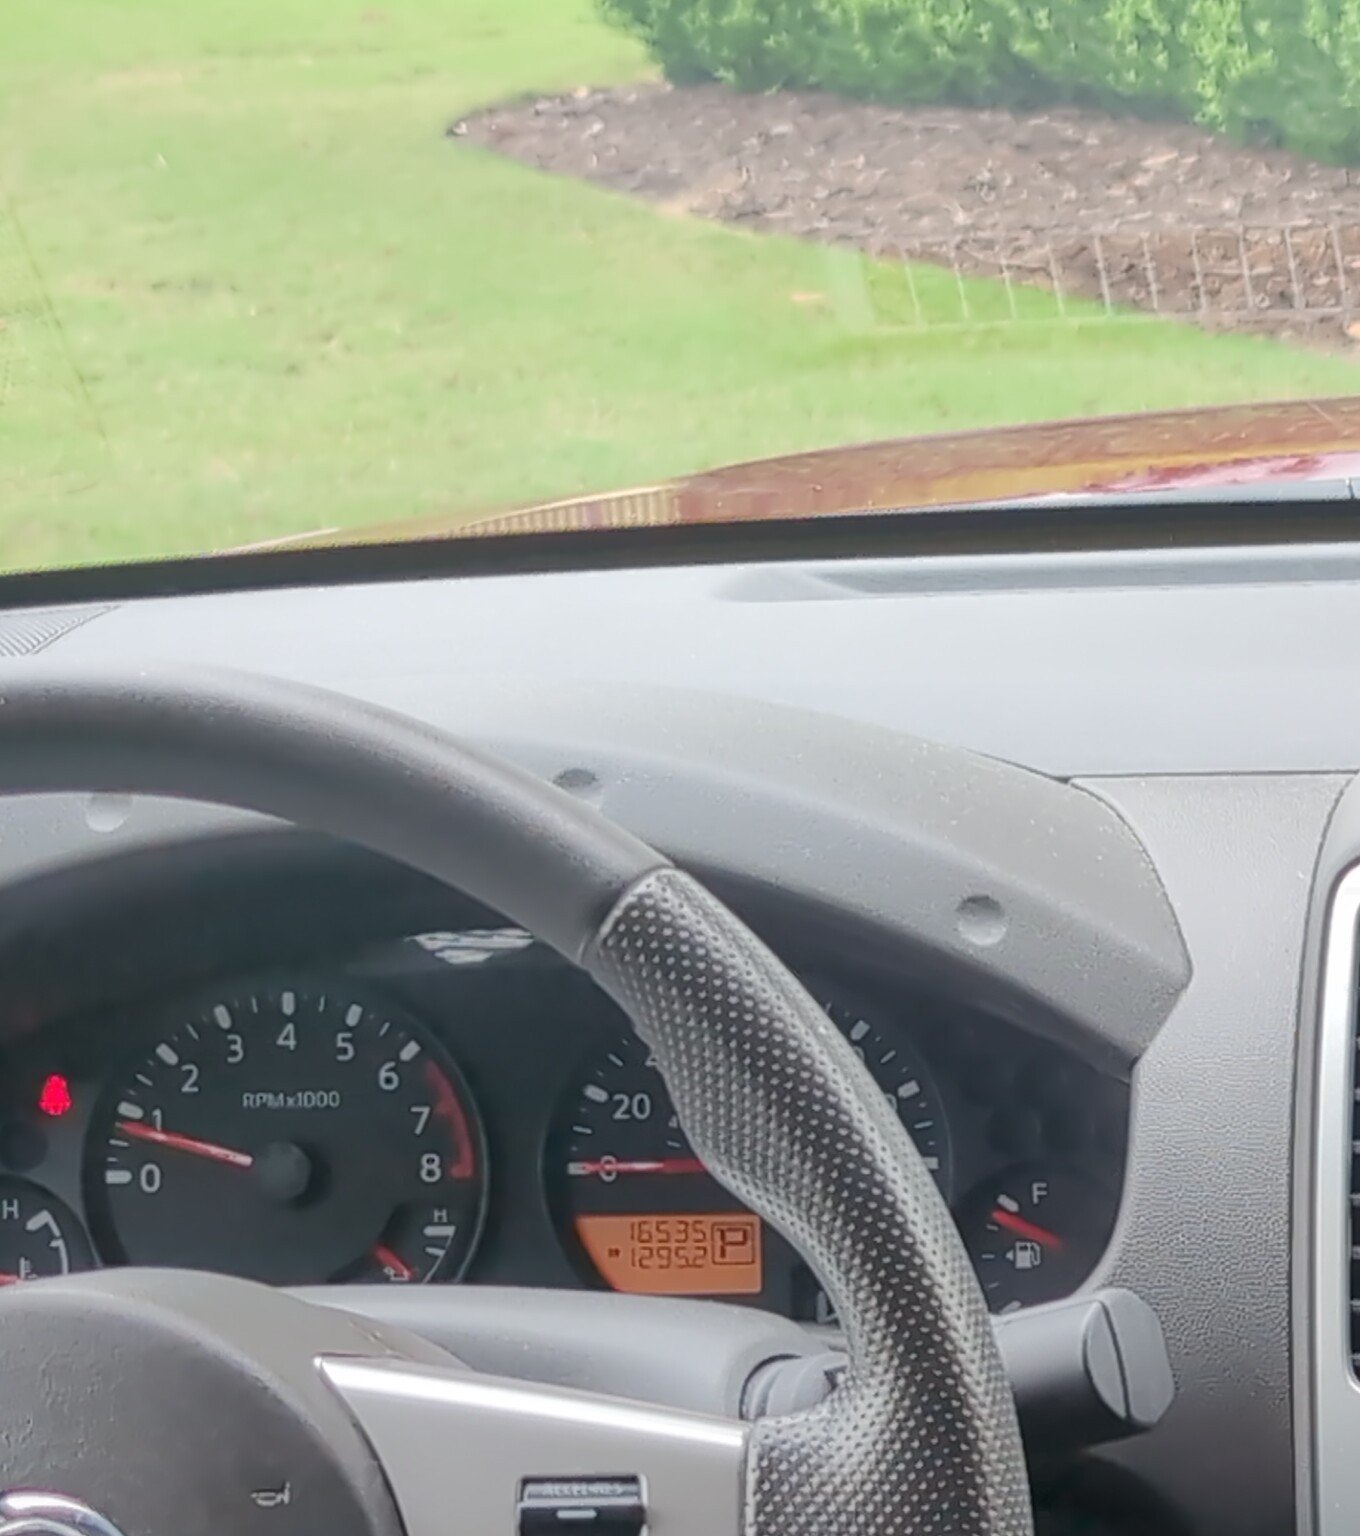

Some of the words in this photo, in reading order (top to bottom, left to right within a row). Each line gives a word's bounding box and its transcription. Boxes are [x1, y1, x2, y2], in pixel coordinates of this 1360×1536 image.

[226, 1034, 244, 1063] 3
[276, 1022, 297, 1050] 4
[336, 1033, 354, 1061] 5
[181, 1064, 199, 1093] 2
[379, 1061, 399, 1090] 6
[152, 1108, 162, 1131] 1
[410, 1106, 431, 1135] 7
[612, 1093, 650, 1120] 20
[140, 1163, 161, 1193] 0
[420, 1153, 442, 1182] 8
[1032, 1183, 1047, 1204] F
[2, 1199, 19, 1219] H
[433, 1209, 448, 1223] H
[717, 1227, 747, 1259] P
